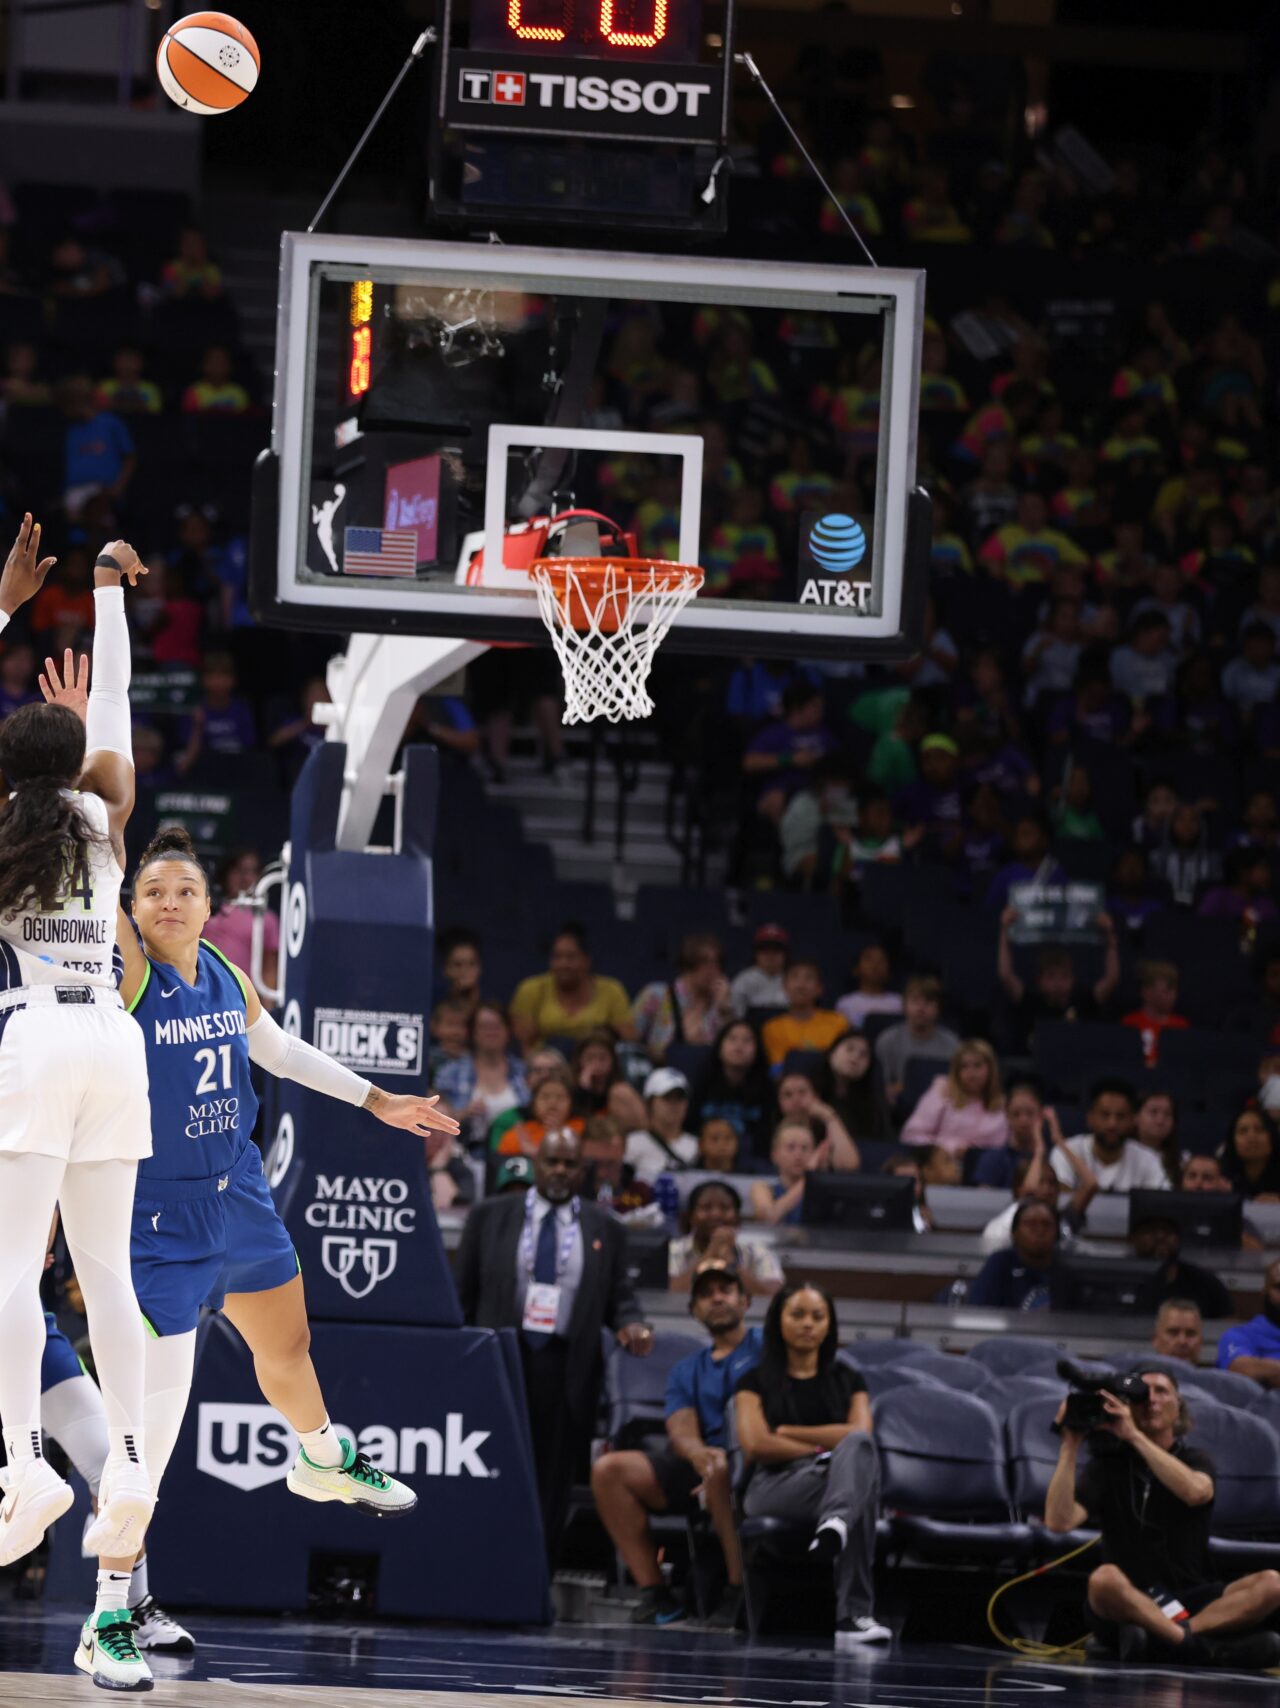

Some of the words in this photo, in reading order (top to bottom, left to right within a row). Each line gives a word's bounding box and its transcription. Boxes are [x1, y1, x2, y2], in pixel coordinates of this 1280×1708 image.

[529, 73, 711, 117] TISSOT
[799, 578, 872, 609] AT&T
[23, 917, 107, 944] OGUNBOWALE
[193, 1043, 233, 1096] 21
[187, 1097, 239, 1121] MAYO
[184, 1113, 240, 1139] CLINIC
[314, 1174, 409, 1204] MAYO
[304, 1202, 417, 1234] CLINIC
[210, 1420, 289, 1467] us
[338, 1411, 492, 1478] ank
